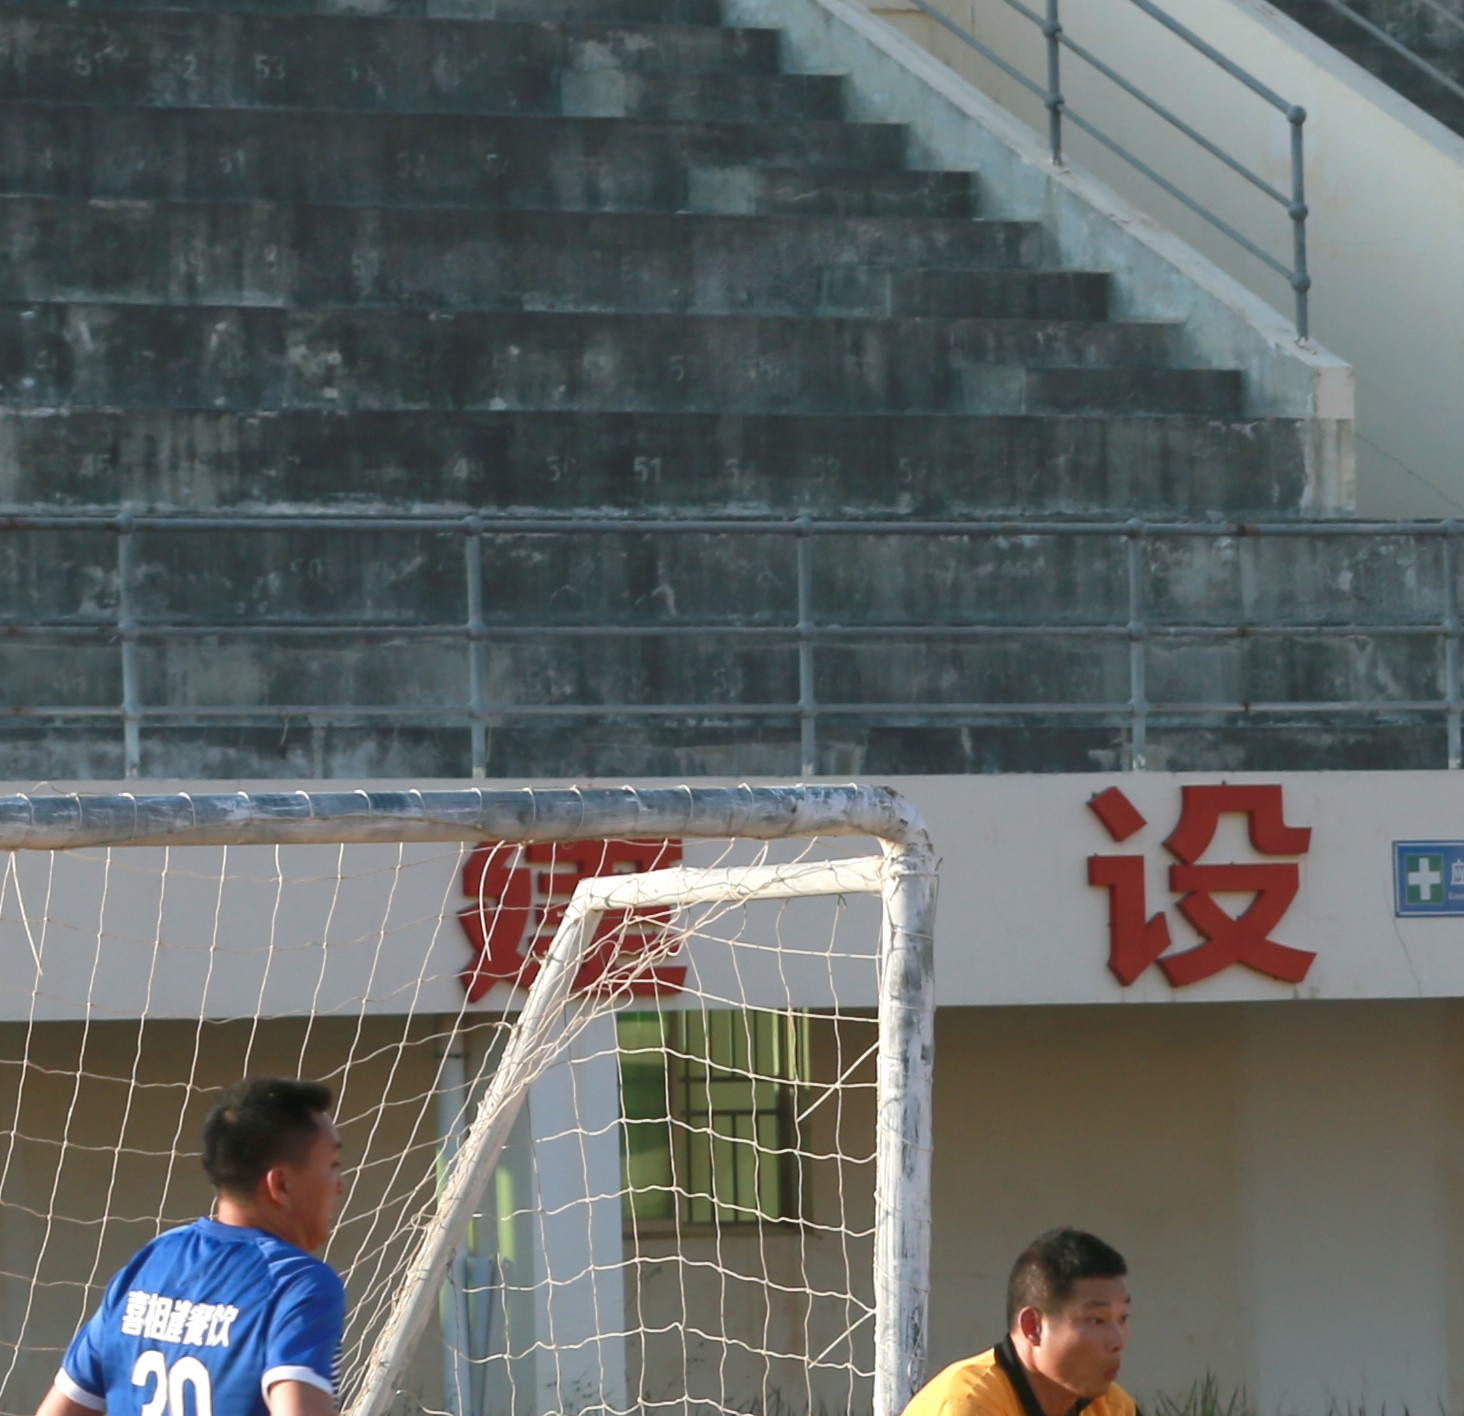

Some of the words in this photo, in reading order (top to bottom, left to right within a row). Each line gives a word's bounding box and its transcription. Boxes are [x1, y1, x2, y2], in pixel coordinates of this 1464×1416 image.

[121, 1289, 240, 1349] 喜相逢餐饮
